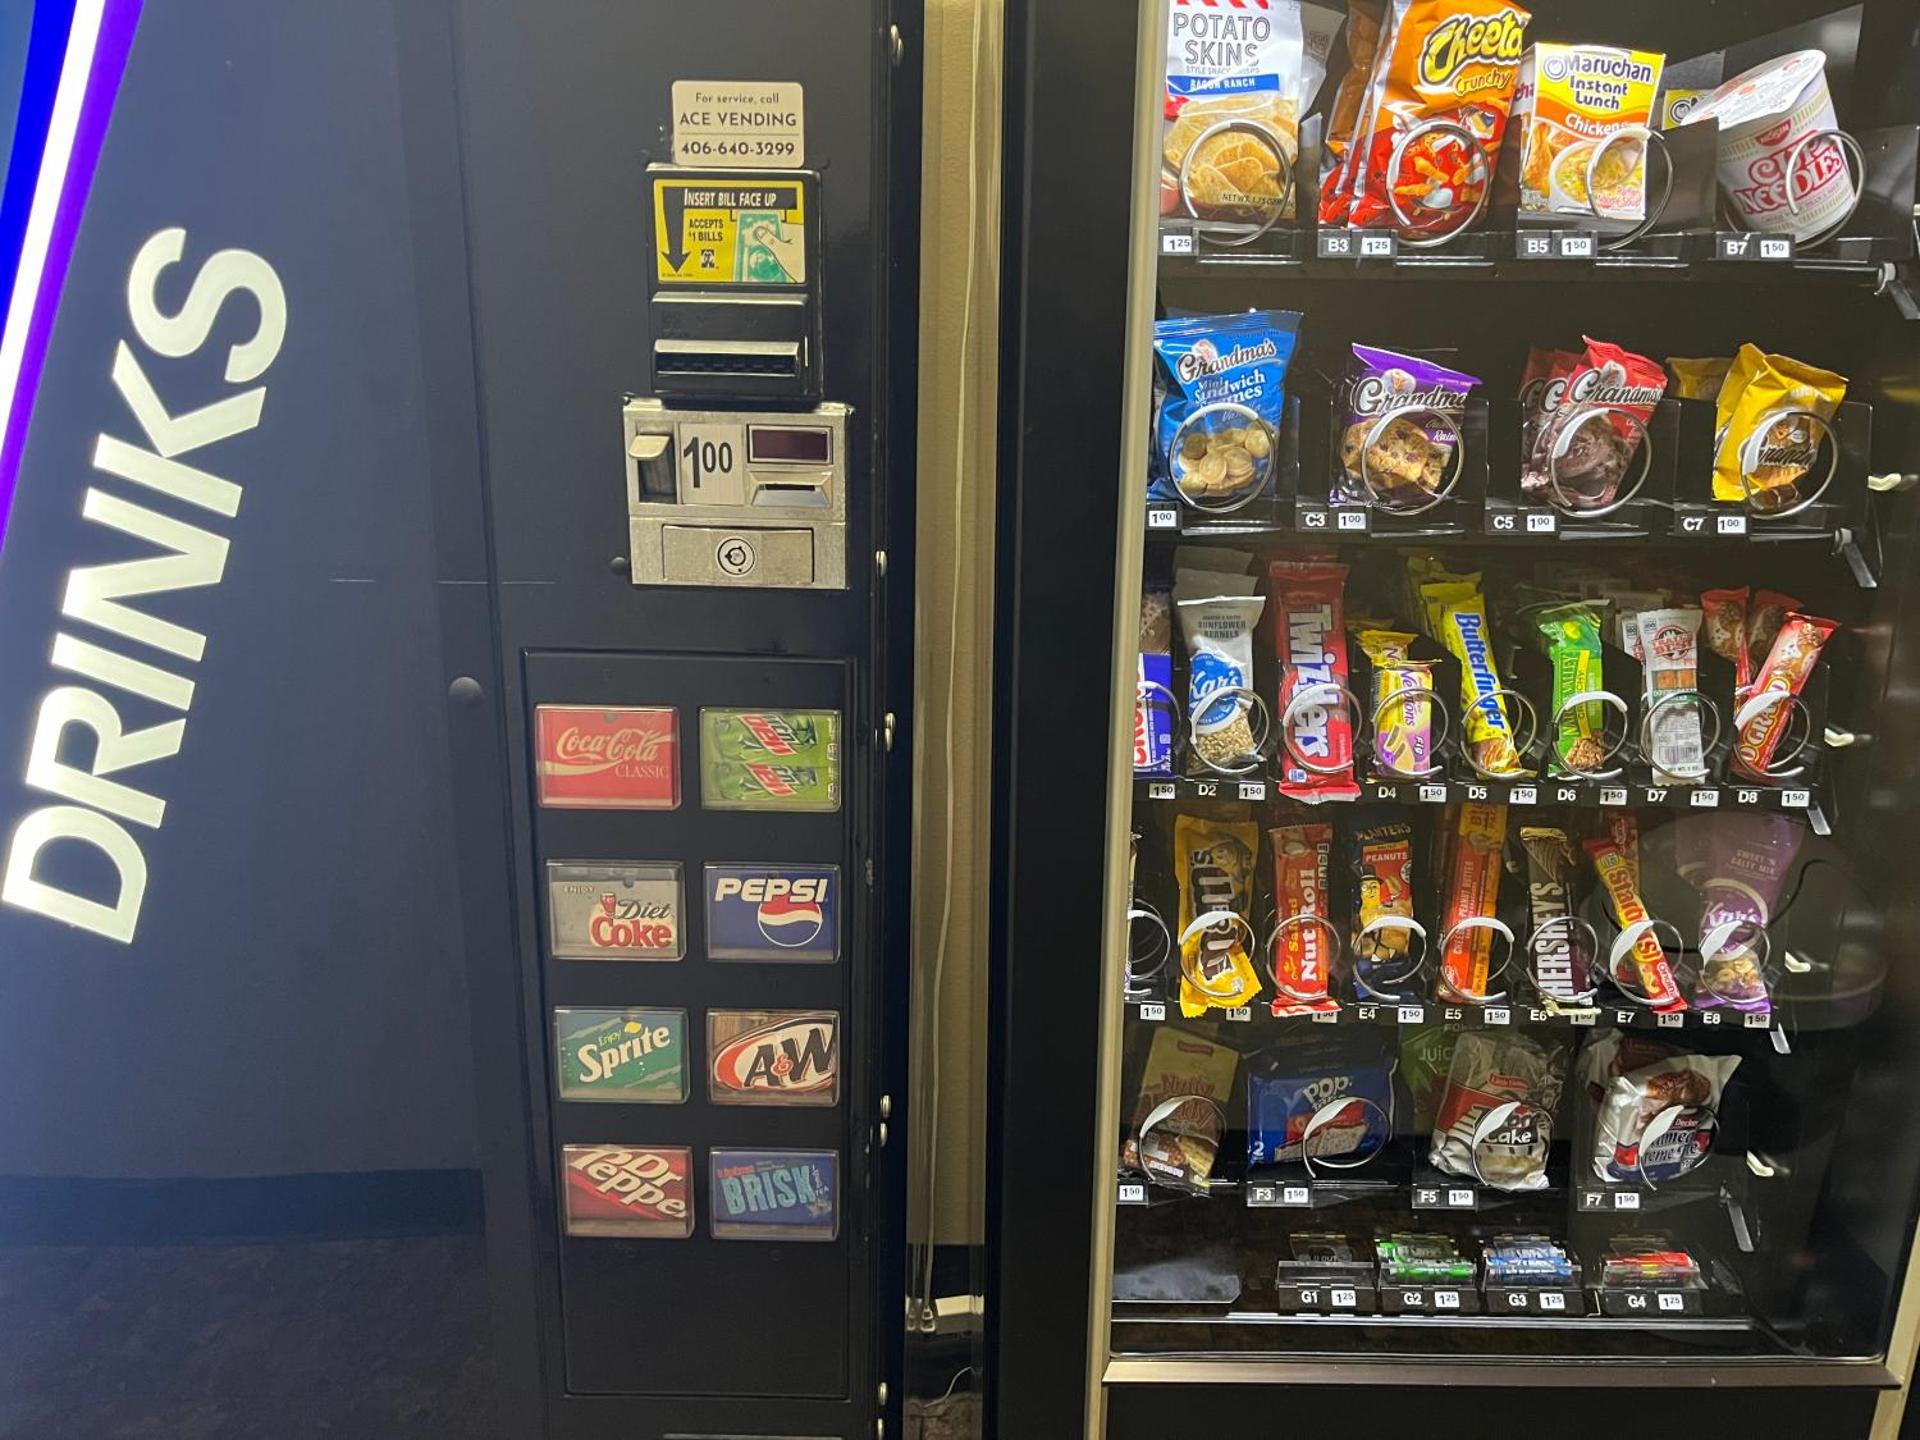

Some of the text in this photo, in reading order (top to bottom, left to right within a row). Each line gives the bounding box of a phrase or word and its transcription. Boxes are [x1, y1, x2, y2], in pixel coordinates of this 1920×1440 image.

[1173, 12, 1271, 42] POTATO
[1185, 39, 1260, 67] SKINS
[1419, 8, 1523, 85] Cheeto
[1566, 53, 1652, 83] Maruchan
[1224, 77, 1256, 88] RANCH
[1453, 67, 1512, 96] Crunchy
[1568, 75, 1628, 97] Instant
[695, 92, 713, 104] For
[760, 92, 779, 104] call
[1574, 88, 1620, 111] Lunch
[680, 111, 797, 127] ACE VENDING
[1564, 112, 1618, 137] Chicken
[681, 141, 795, 156] 406-640-3299
[717, 192, 737, 207] BILL
[738, 192, 762, 207] FACE
[764, 192, 777, 207] UP
[688, 218, 724, 230] ACCEPTS
[698, 232, 723, 242] BILLS
[1328, 239, 1348, 253] B3
[1527, 240, 1548, 253] B5
[1726, 242, 1748, 255] B7
[1177, 338, 1276, 384] Grandma's
[1194, 368, 1265, 401] Sandwich
[1305, 514, 1326, 527] C3
[1493, 516, 1513, 530] C5
[1683, 517, 1703, 531] C7
[1, 227, 287, 944] DRINKS
[1454, 612, 1505, 729] Butterfinger
[1561, 654, 1578, 694] VALLEY
[1288, 603, 1341, 759] Twizlers
[1746, 677, 1790, 747] GRAD
[615, 764, 668, 779] CLASSIC
[1198, 785, 1217, 797] D2
[1378, 786, 1396, 798] D4
[1468, 786, 1487, 799] D5
[1557, 789, 1577, 801] D6
[1647, 791, 1668, 802] D7
[1738, 791, 1758, 803] D8
[1365, 851, 1409, 862] PEANUTS
[714, 878, 829, 903] PEPSI
[613, 899, 670, 920] Diet
[591, 917, 673, 949] Coke
[1301, 929, 1317, 982] Nut
[1359, 1009, 1376, 1020] E4
[1445, 1009, 1462, 1020] E5
[1530, 1011, 1546, 1021] E6
[1617, 1012, 1634, 1023] E7
[1703, 1013, 1721, 1024] E8
[575, 1025, 671, 1083] Sprite
[622, 1153, 683, 1187] Dr
[720, 1165, 816, 1215] BRISK
[1420, 1191, 1437, 1203] F5
[1586, 1194, 1602, 1206] F7
[1301, 1290, 1318, 1303] G1
[1404, 1292, 1422, 1305] G2
[1508, 1294, 1527, 1307] G3
[1627, 1295, 1646, 1308] G4
